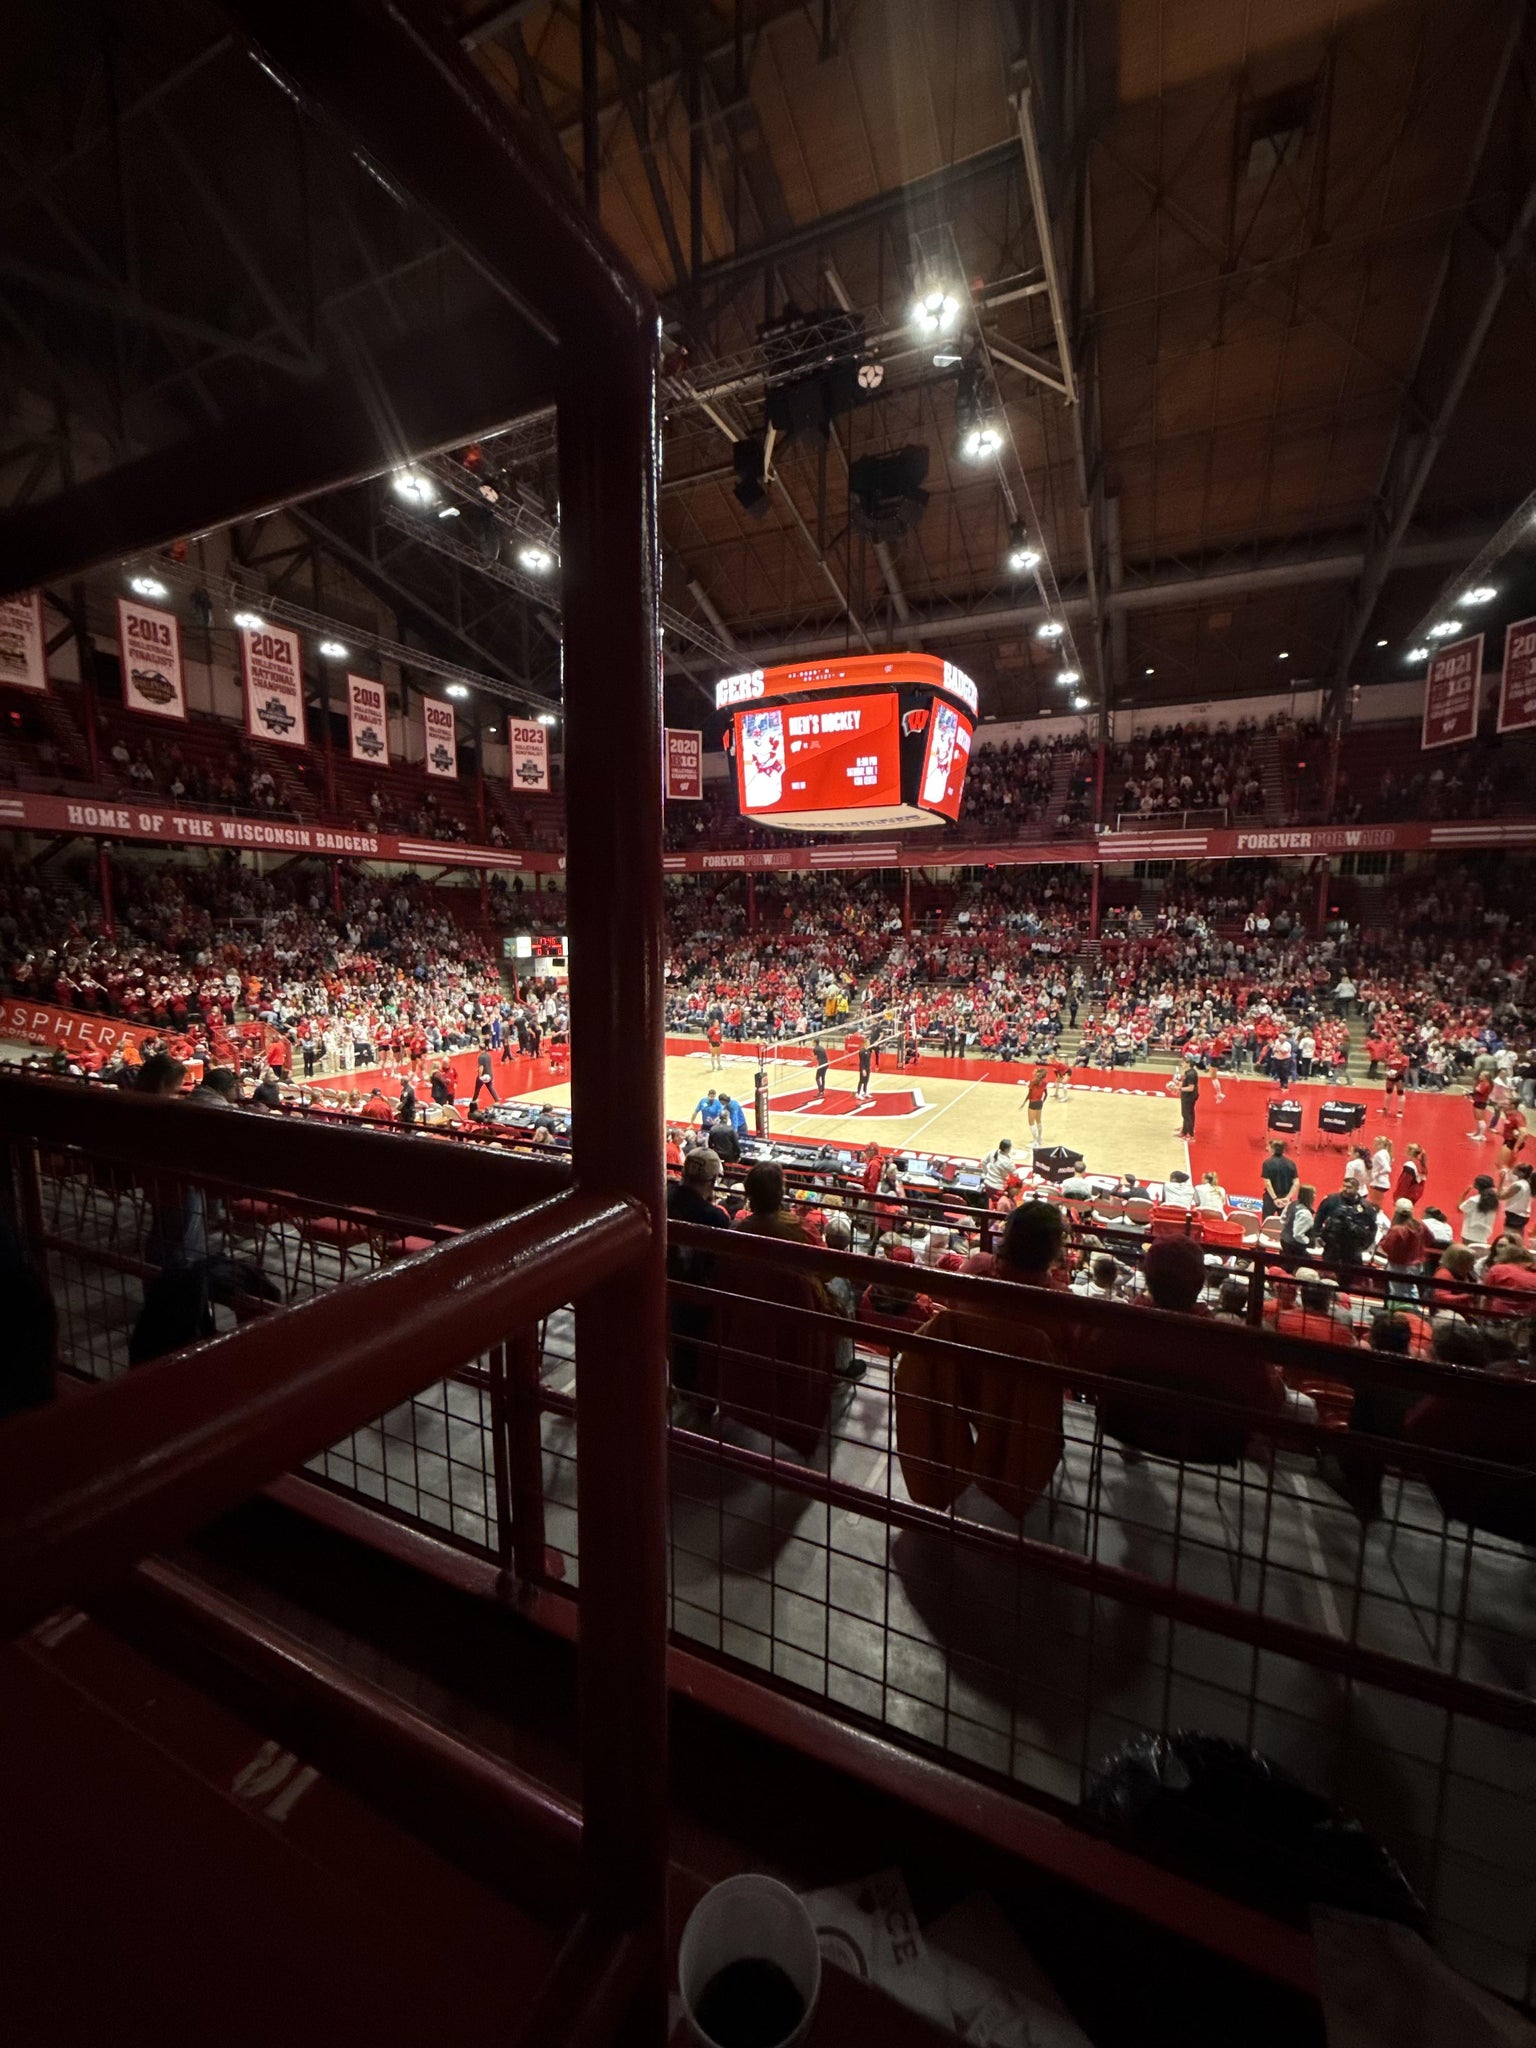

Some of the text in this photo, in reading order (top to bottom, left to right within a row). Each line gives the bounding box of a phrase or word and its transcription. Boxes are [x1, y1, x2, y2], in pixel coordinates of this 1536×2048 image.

[127, 615, 171, 647] 2013
[250, 631, 293, 665] 2021
[251, 666, 296, 688] NATIONAL
[252, 677, 297, 697] CHAMPIONS
[353, 687, 381, 709] 2019
[427, 707, 452, 728] 2020
[821, 710, 861, 733] HOCKEY
[514, 727, 544, 744] 2023
[670, 738, 698, 754] 2020
[67, 805, 378, 852] HOME OF THE WISCONSIN BADGERS
[1237, 832, 1311, 850] FOREVER
[702, 854, 745, 868] FOREVER
